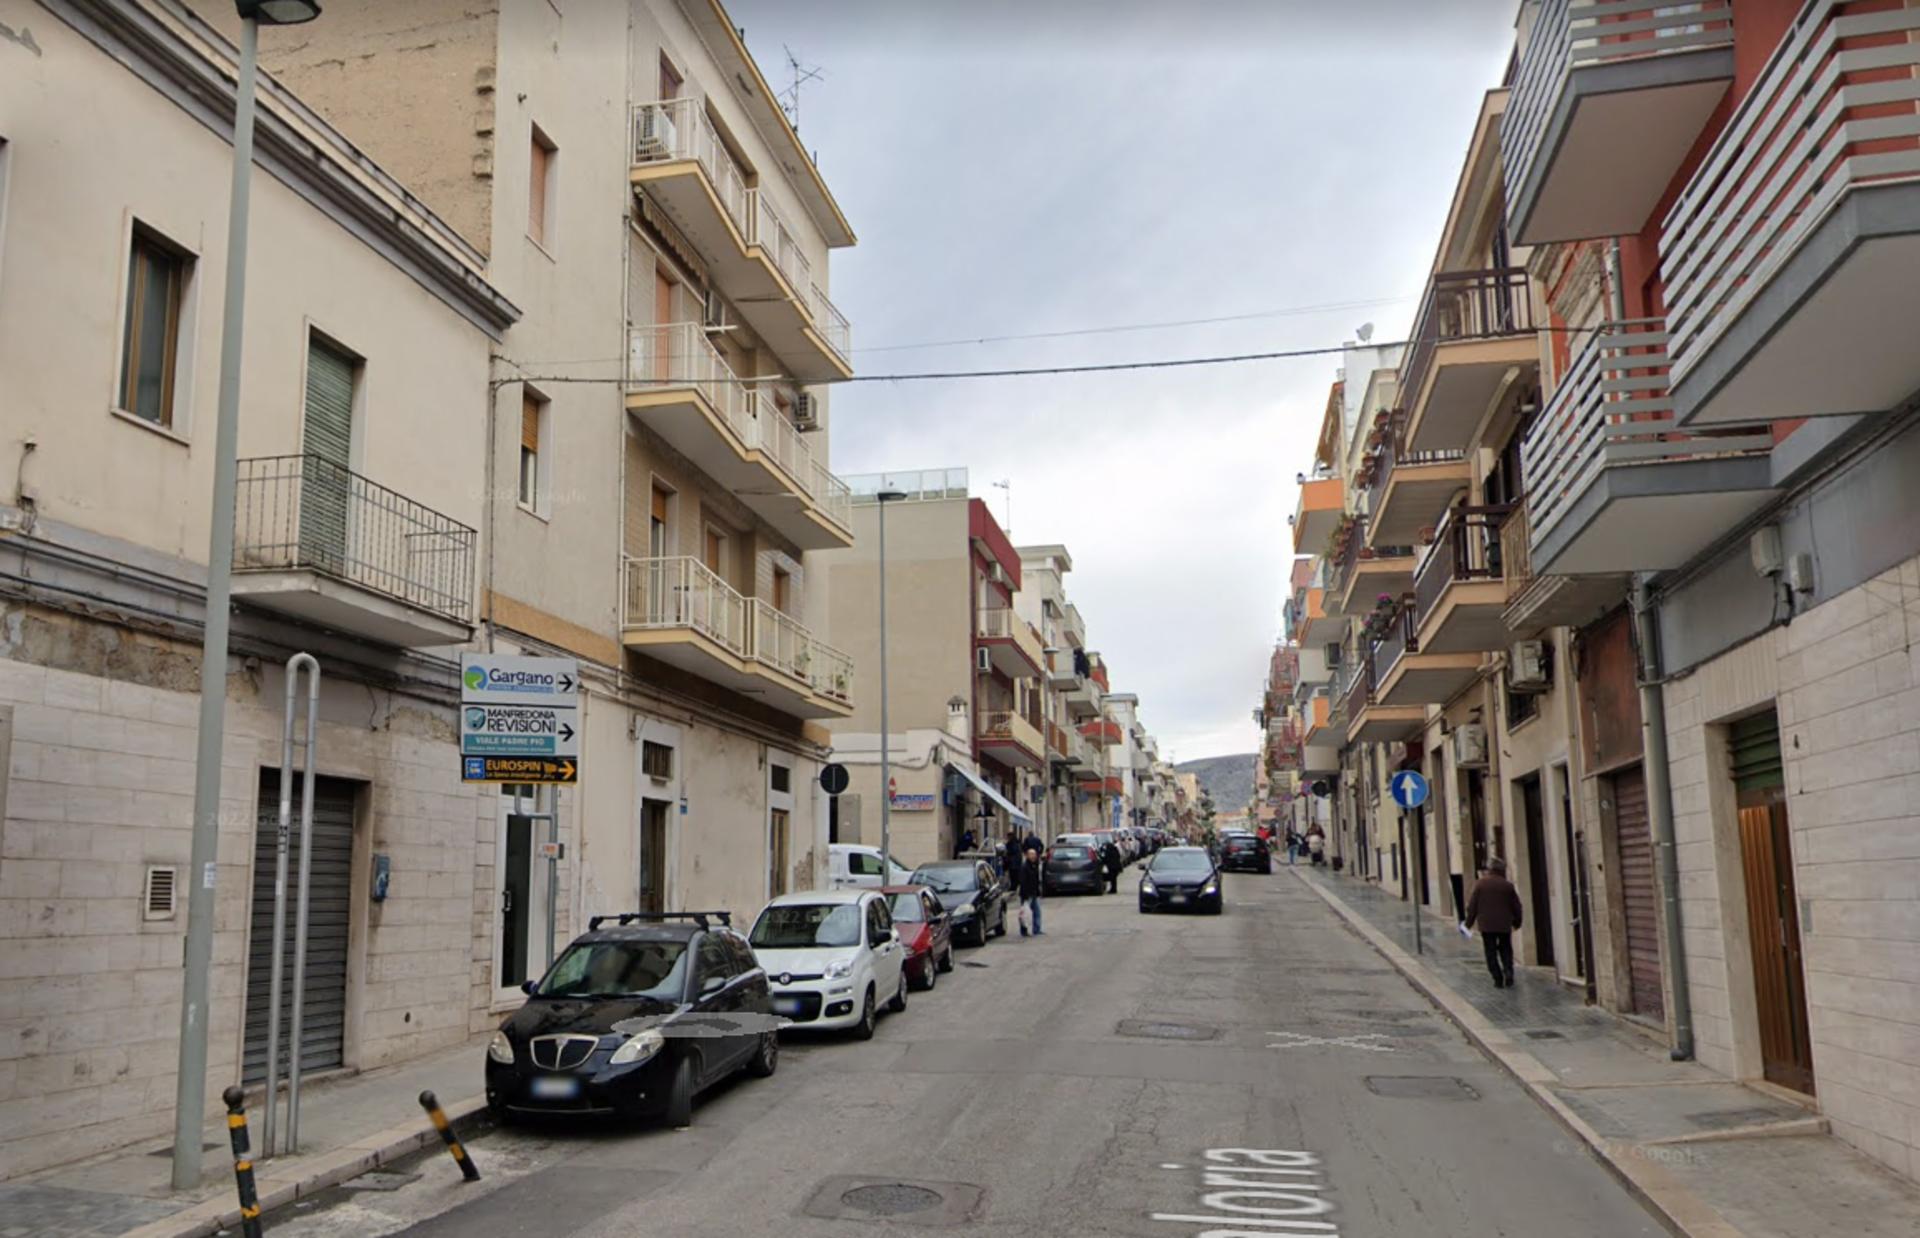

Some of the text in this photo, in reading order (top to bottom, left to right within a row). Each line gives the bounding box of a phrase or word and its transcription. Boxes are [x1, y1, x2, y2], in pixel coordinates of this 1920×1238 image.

[488, 668, 554, 686] Gargano
[487, 708, 556, 720] MANFREDONIA
[487, 718, 556, 734] REVISIONI
[486, 759, 541, 772] EUROSPIN
